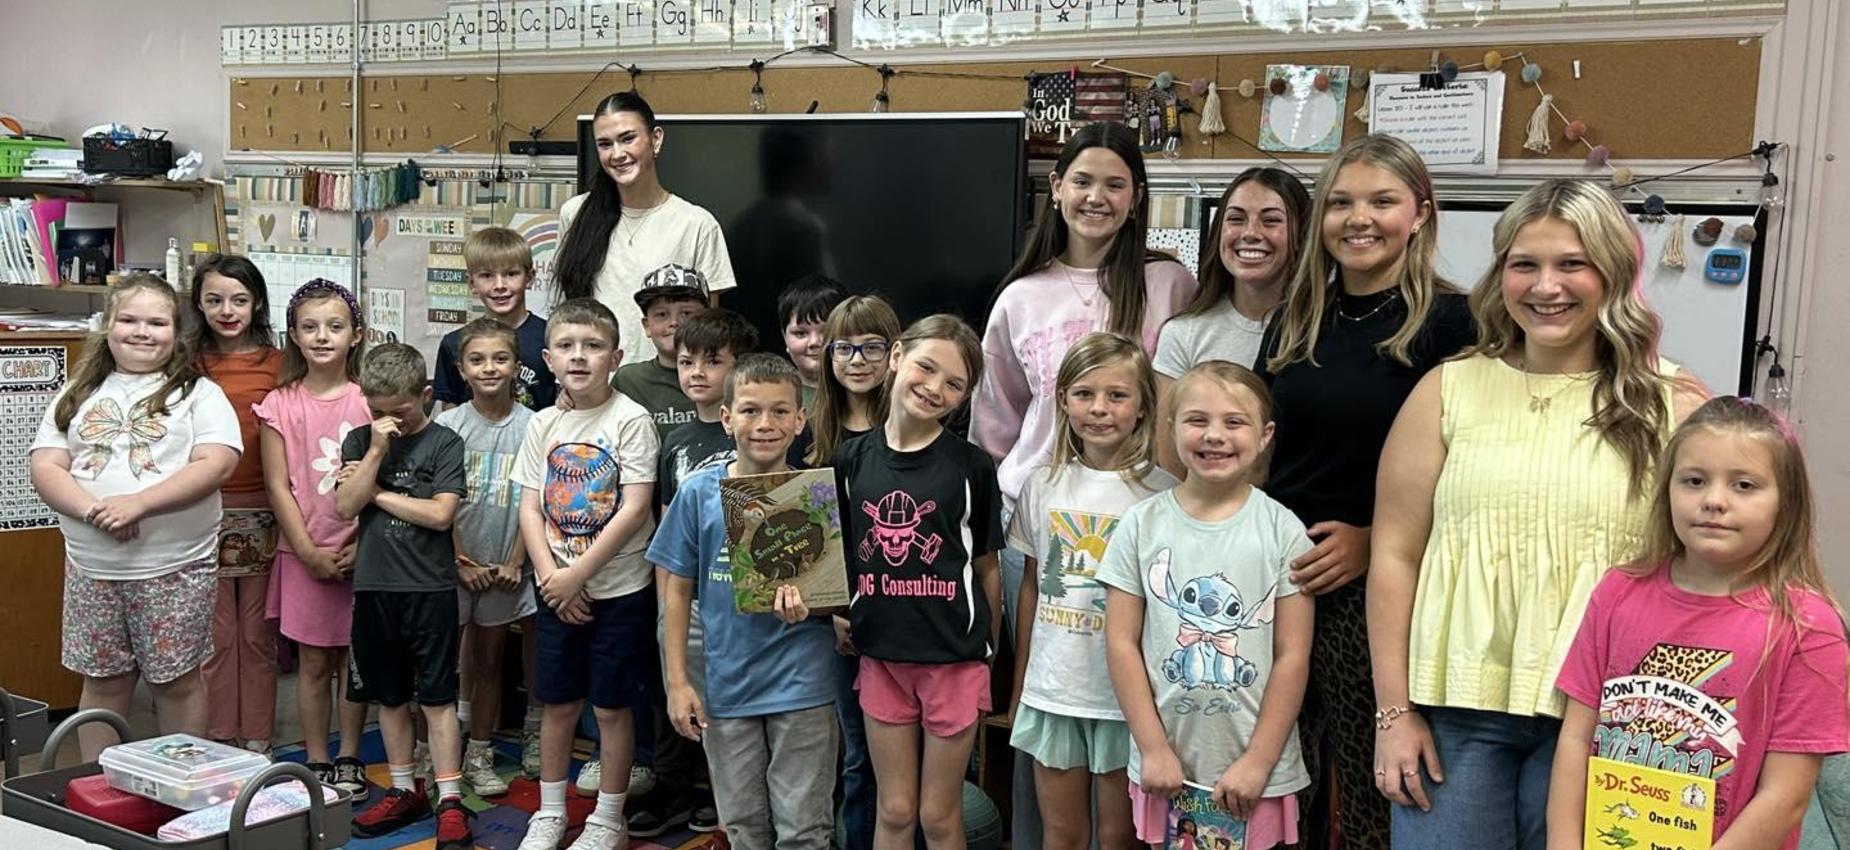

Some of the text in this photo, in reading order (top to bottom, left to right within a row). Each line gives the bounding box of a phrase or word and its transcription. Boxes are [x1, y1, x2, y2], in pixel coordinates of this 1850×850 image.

[452, 13, 475, 35] Aa
[486, 10, 507, 33] Bb
[520, 8, 541, 31] Cc
[554, 6, 576, 30] Dd
[591, 5, 609, 29] Ee
[627, 2, 642, 27] Ff
[661, 0, 687, 35] Gg
[701, 0, 723, 23] Hh
[249, 28, 256, 48] 2
[270, 28, 279, 47] 3
[291, 28, 300, 46] 4
[313, 27, 323, 46] 5
[336, 27, 345, 46] 6
[360, 26, 368, 45] 7
[383, 24, 391, 45] 8
[407, 24, 415, 43] 9
[427, 22, 441, 43] 10
[1032, 88, 1045, 98] In
[1032, 98, 1070, 121] God
[1031, 122, 1052, 134] We
[399, 218, 423, 233] DAYS
[435, 242, 462, 253] SUNDAY
[433, 270, 463, 281] TUESDAY
[434, 312, 459, 322] FRIDAY
[2, 359, 51, 379] CHART
[764, 523, 788, 537] One
[754, 523, 813, 560] Small Place
[784, 539, 810, 554] Tree
[881, 573, 957, 601] Consulting
[1039, 606, 1085, 629] SUNNY
[1603, 679, 1728, 729] DON'T MAKE ME
[1644, 697, 1677, 722] like
[1676, 713, 1709, 747] my
[1604, 773, 1628, 792] Dr.
[1629, 775, 1671, 802] Seuss
[1172, 794, 1205, 815] Wish
[1649, 811, 1697, 831] One fish
